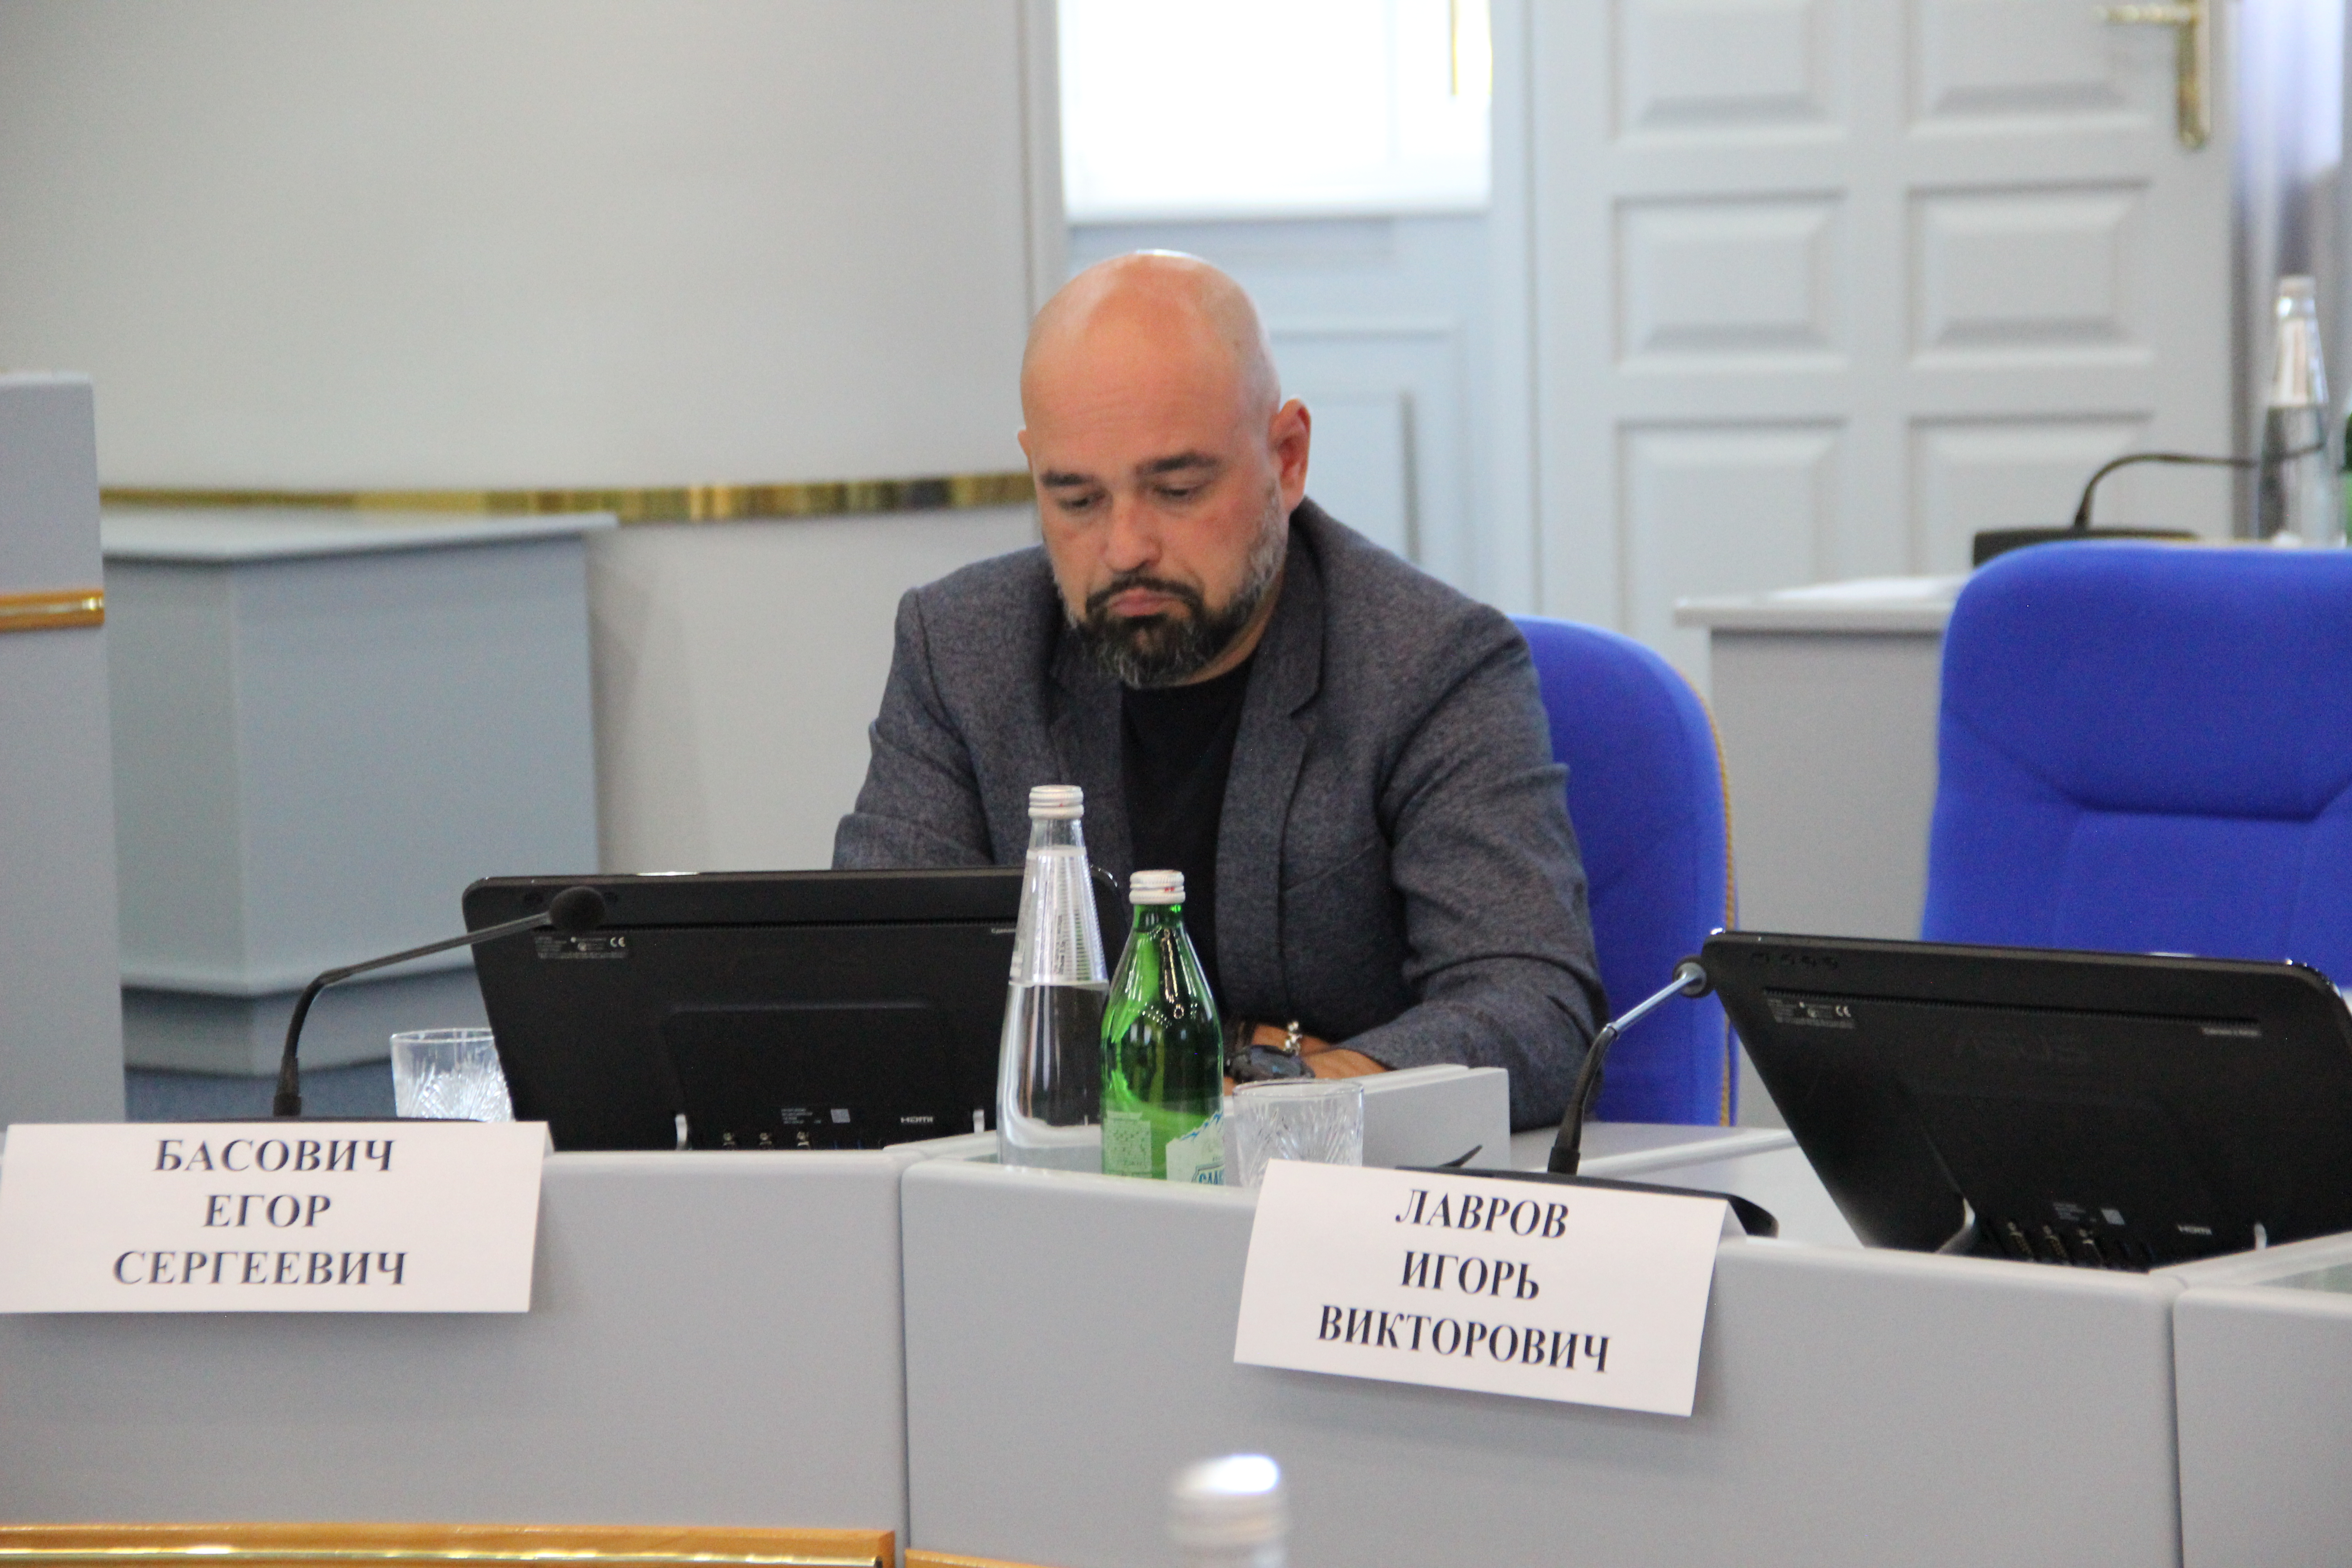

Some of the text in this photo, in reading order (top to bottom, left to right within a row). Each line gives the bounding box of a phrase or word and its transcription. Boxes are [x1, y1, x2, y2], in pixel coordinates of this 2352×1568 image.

[154, 1139, 394, 1171] БАСОВИЧ
[203, 1194, 332, 1228] ЕГОР
[1395, 1188, 1569, 1240] ЛАВРОВ
[113, 1250, 408, 1286] СЕРГЕЕВИЧ
[1399, 1250, 1539, 1300] ИГОРЬ
[1317, 1304, 1611, 1373] ВИКТОРОВИЧ
